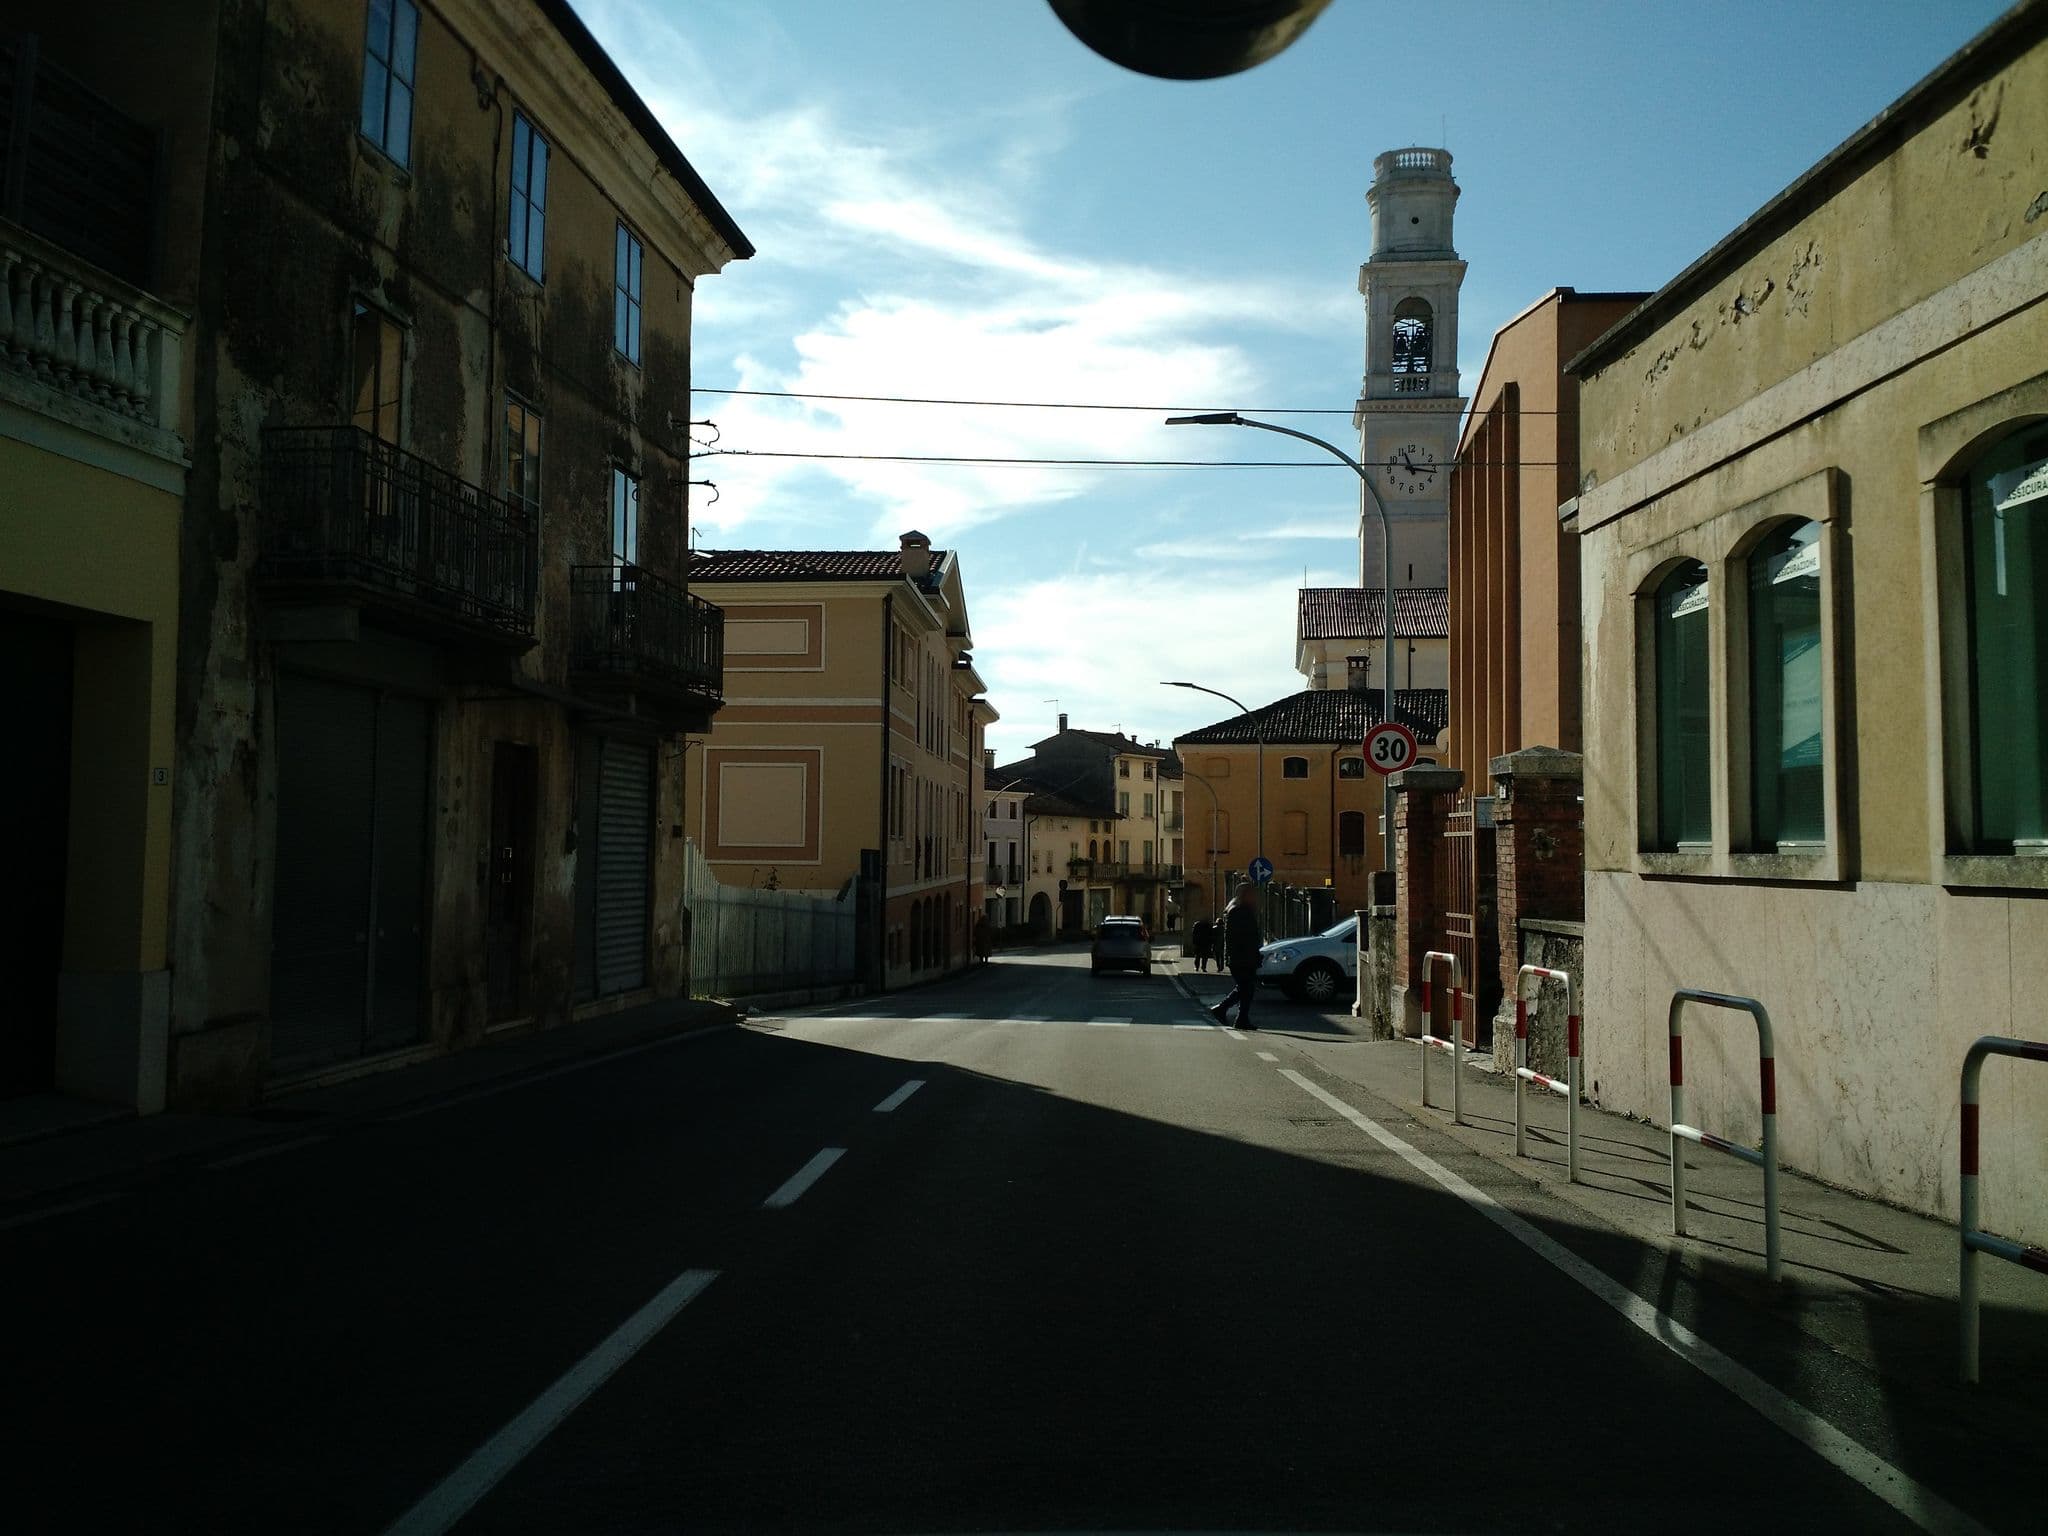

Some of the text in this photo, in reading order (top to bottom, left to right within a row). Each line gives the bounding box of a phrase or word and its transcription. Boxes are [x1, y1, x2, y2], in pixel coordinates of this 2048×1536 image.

[1398, 447, 1404, 457] 11
[1407, 444, 1416, 453] 12
[1389, 455, 1398, 464] 10
[1427, 453, 1433, 463] 2
[1386, 464, 1392, 474] 9
[1390, 475, 1395, 485] 8
[1426, 474, 1433, 484] 4
[1398, 482, 1405, 491] 7
[1408, 485, 1415, 495] 6
[1419, 482, 1425, 491] 5
[1374, 736, 1406, 763] 30
[158, 770, 164, 782] 3
